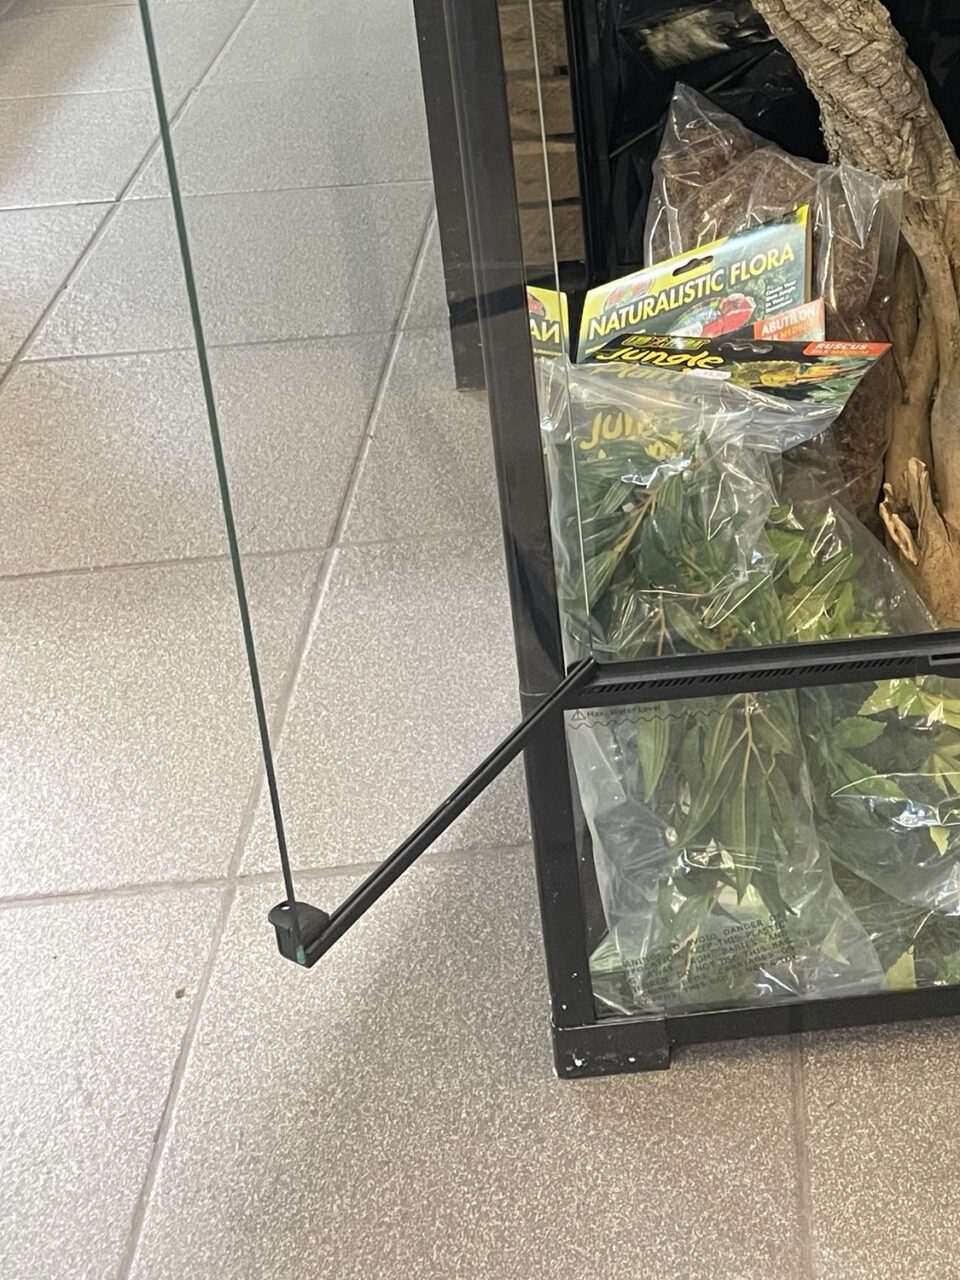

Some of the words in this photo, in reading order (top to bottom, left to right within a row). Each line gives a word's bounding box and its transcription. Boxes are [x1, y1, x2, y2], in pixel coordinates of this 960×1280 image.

[588, 268, 725, 341] NATURALISTIC
[728, 241, 796, 287] FLORA
[761, 305, 817, 337] ABUTILON
[596, 346, 724, 368] Jungle
[815, 342, 869, 350] RUSCUS
